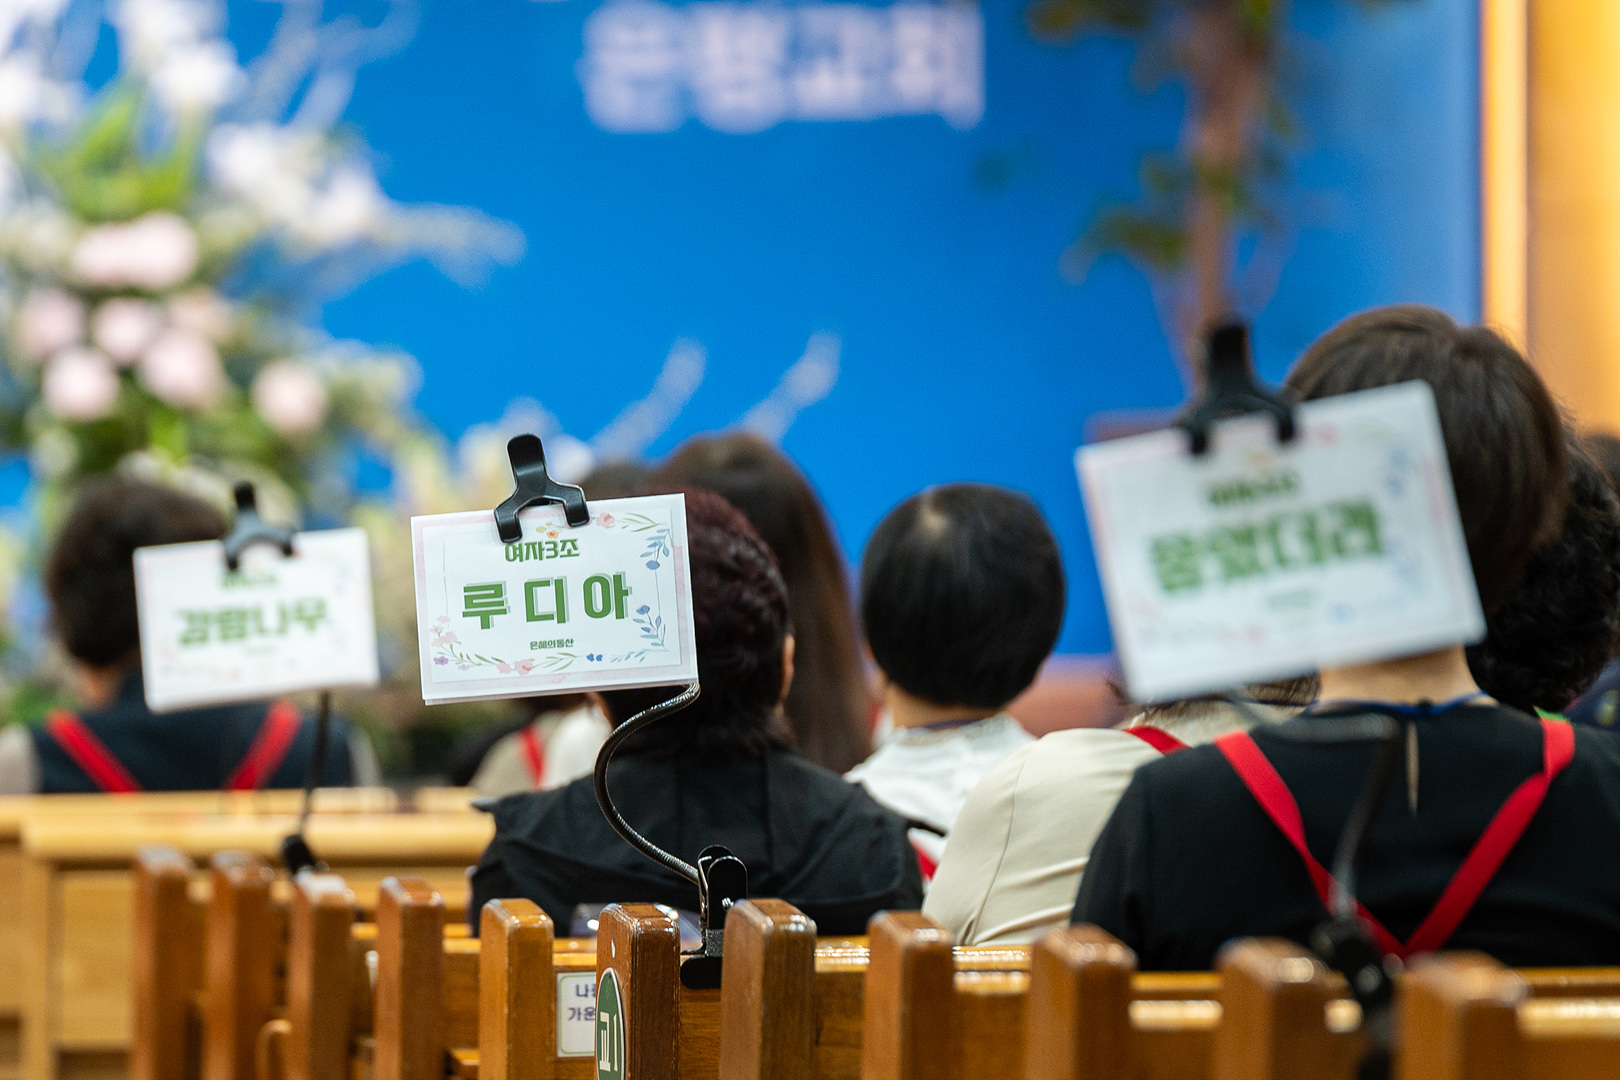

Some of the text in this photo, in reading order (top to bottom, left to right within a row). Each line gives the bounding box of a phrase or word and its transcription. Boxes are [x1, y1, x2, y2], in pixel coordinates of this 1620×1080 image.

[504, 539, 580, 562] 여자3조
[530, 638, 575, 650] 은혜의동산
[575, 983, 596, 998] 나
